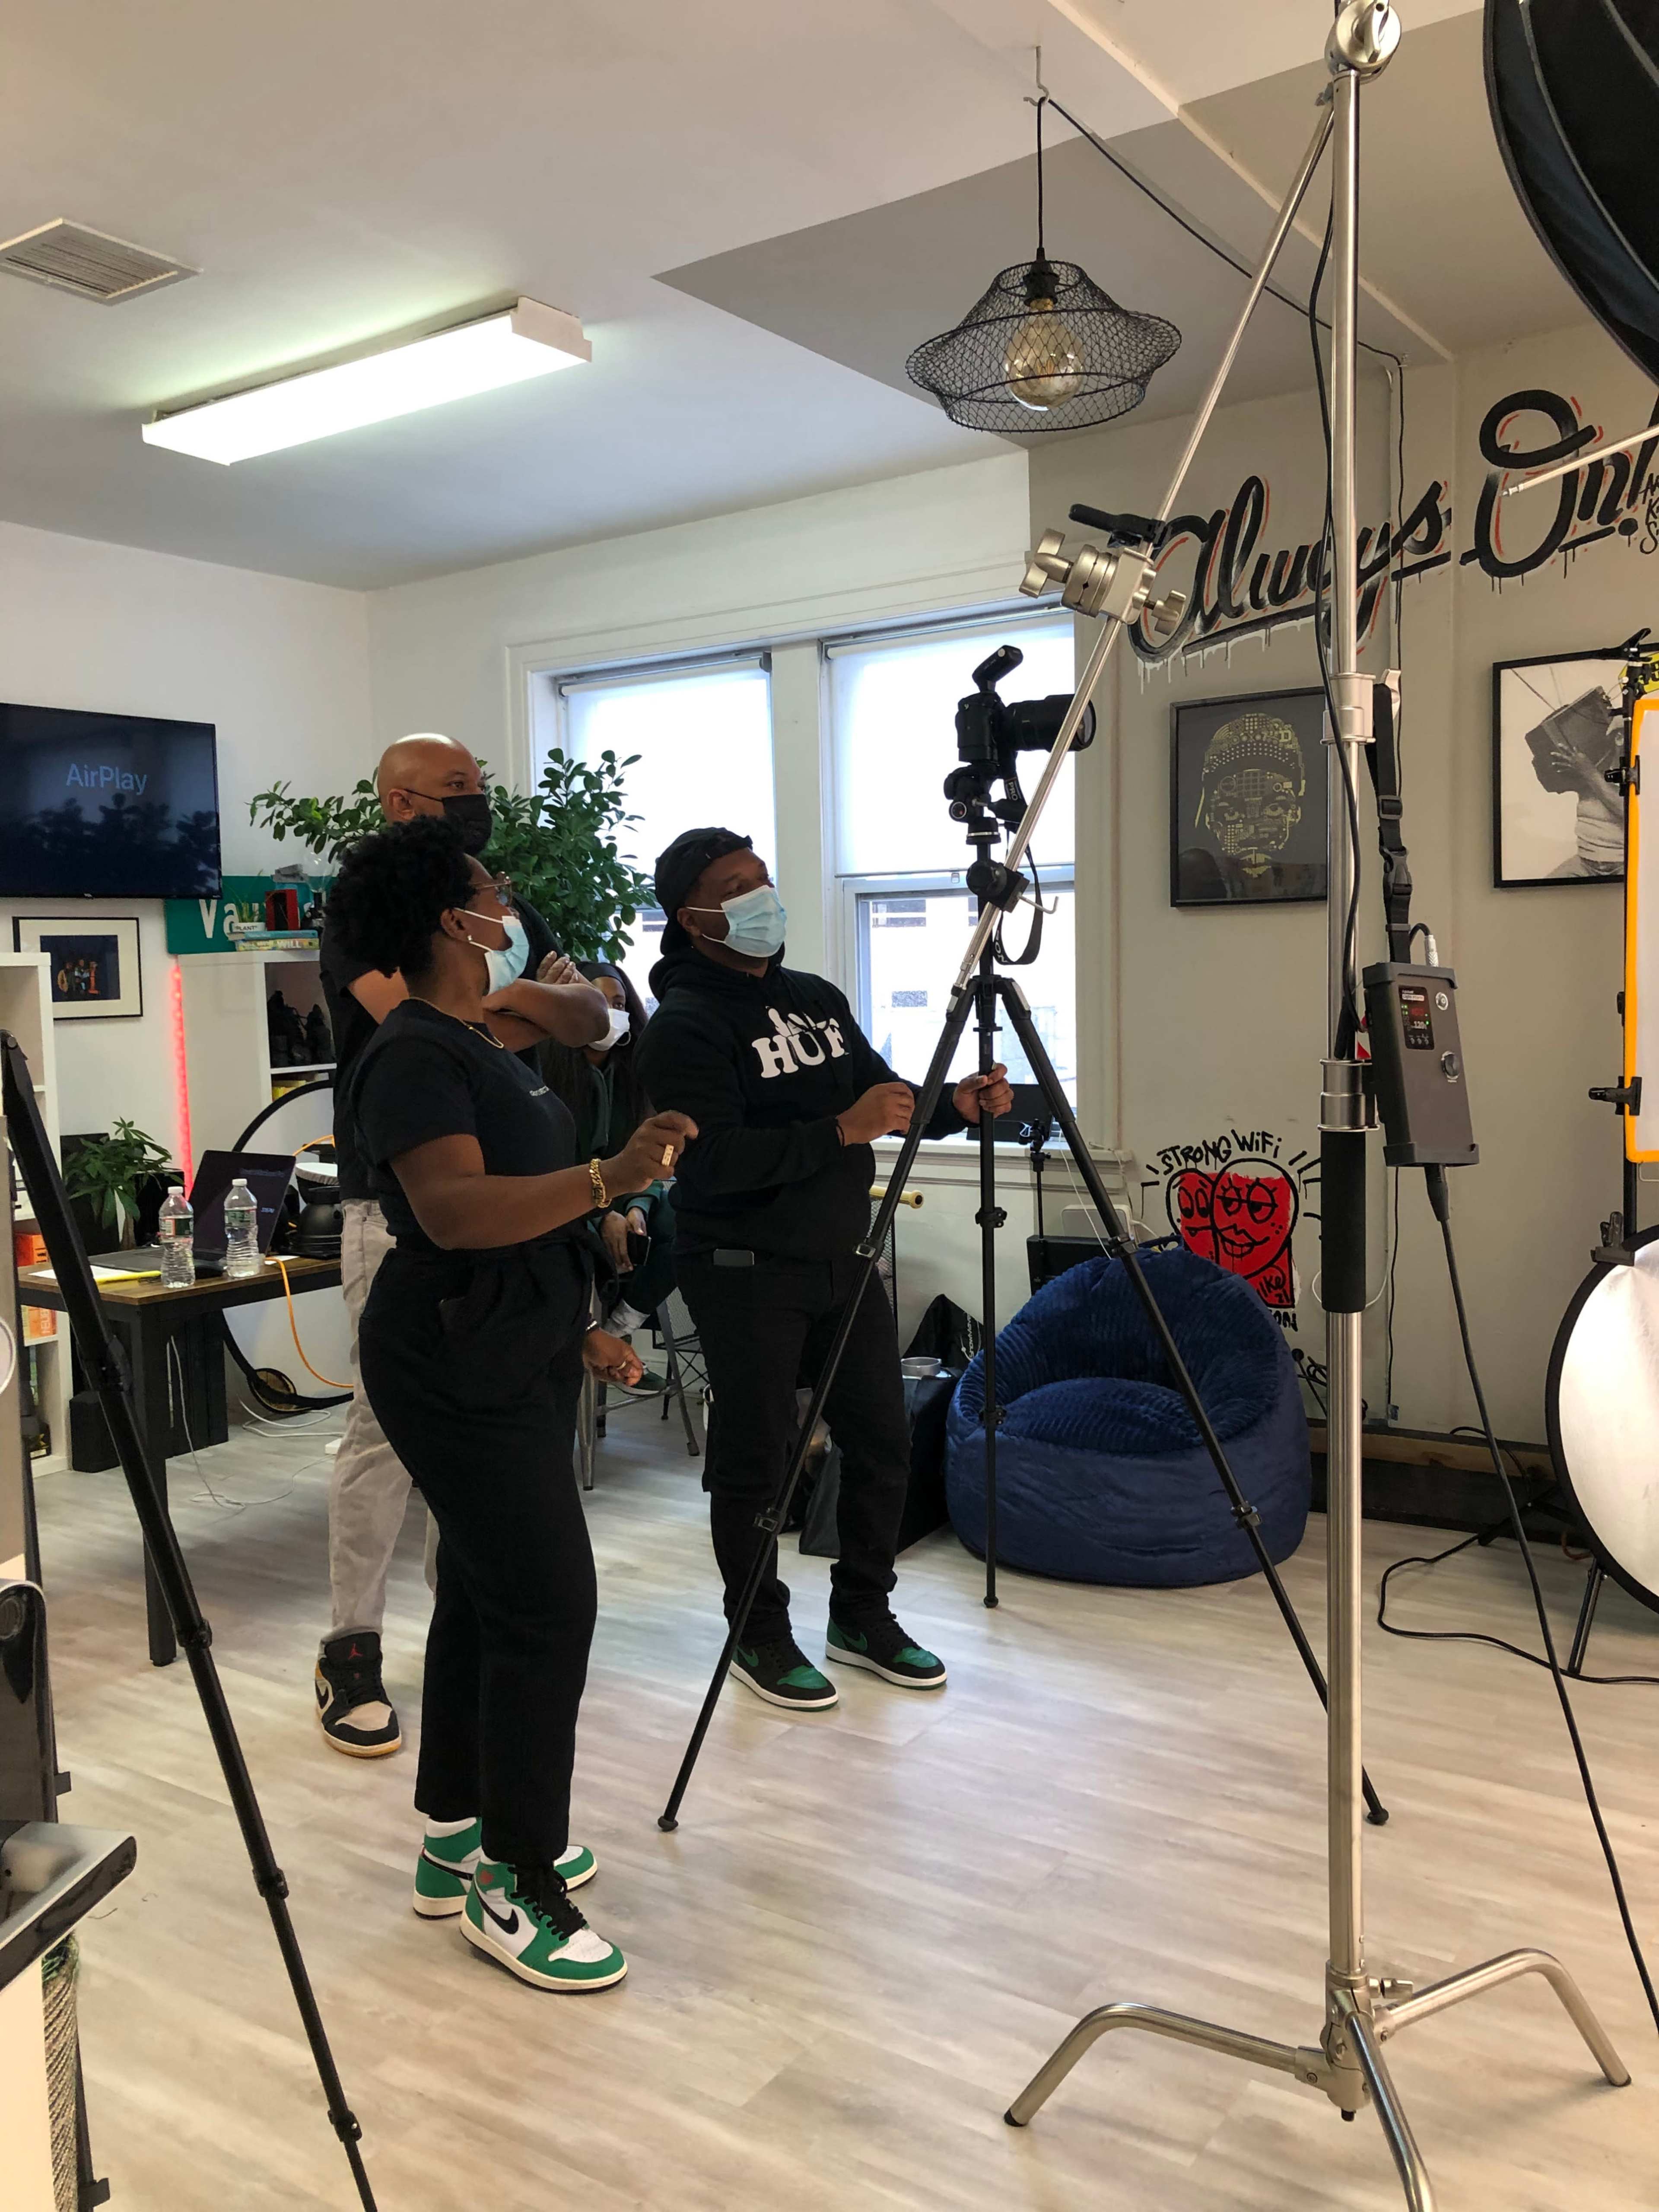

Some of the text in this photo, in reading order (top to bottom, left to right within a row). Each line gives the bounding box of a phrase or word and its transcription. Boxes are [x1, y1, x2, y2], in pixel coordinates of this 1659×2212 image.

[66, 763, 147, 795] AirPlay
[1008, 782, 1018, 801] PRO
[751, 1018, 844, 1079] HUF
[1157, 1135, 1232, 1175] STRONG
